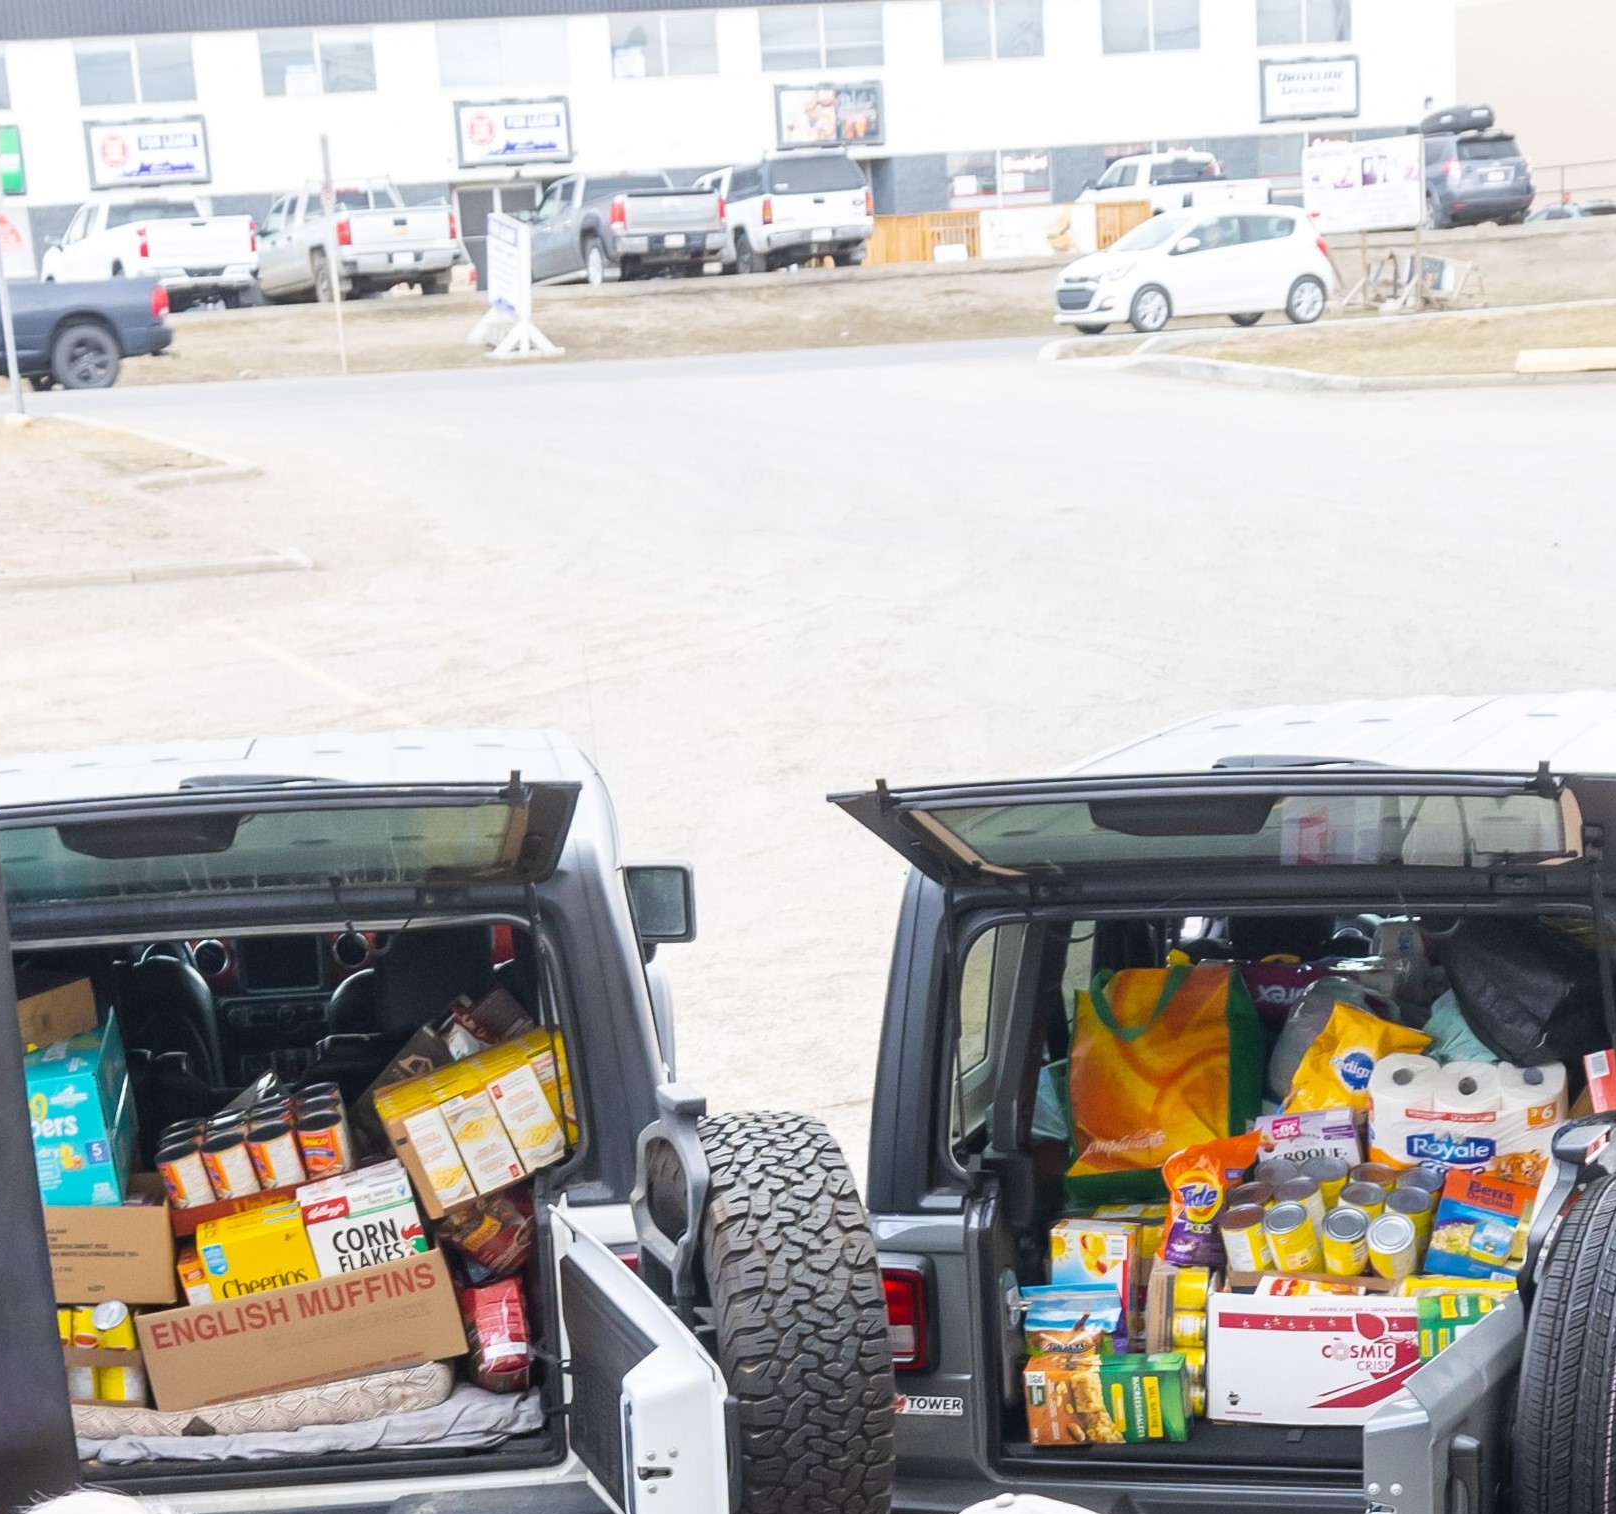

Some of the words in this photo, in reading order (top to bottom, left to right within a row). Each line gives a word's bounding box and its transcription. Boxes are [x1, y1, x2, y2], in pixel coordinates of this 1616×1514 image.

[1411, 1136, 1490, 1161] Royale
[1178, 1184, 1217, 1207] Tide
[1466, 1179, 1515, 1203] Ben's
[307, 1199, 346, 1221] Kellogg's
[332, 1217, 400, 1254] CORN
[1184, 1222, 1212, 1235] PODS
[338, 1241, 405, 1274] FLAKES
[149, 1297, 290, 1350] ENGLISH
[295, 1261, 437, 1320] MUFFINS
[1321, 1343, 1395, 1361] COSMIC
[1356, 1359, 1392, 1372] CRISP
[909, 1397, 962, 1410] TOWER
[1147, 1386, 1158, 1399] VAL
[1149, 1401, 1160, 1429] NATURE
